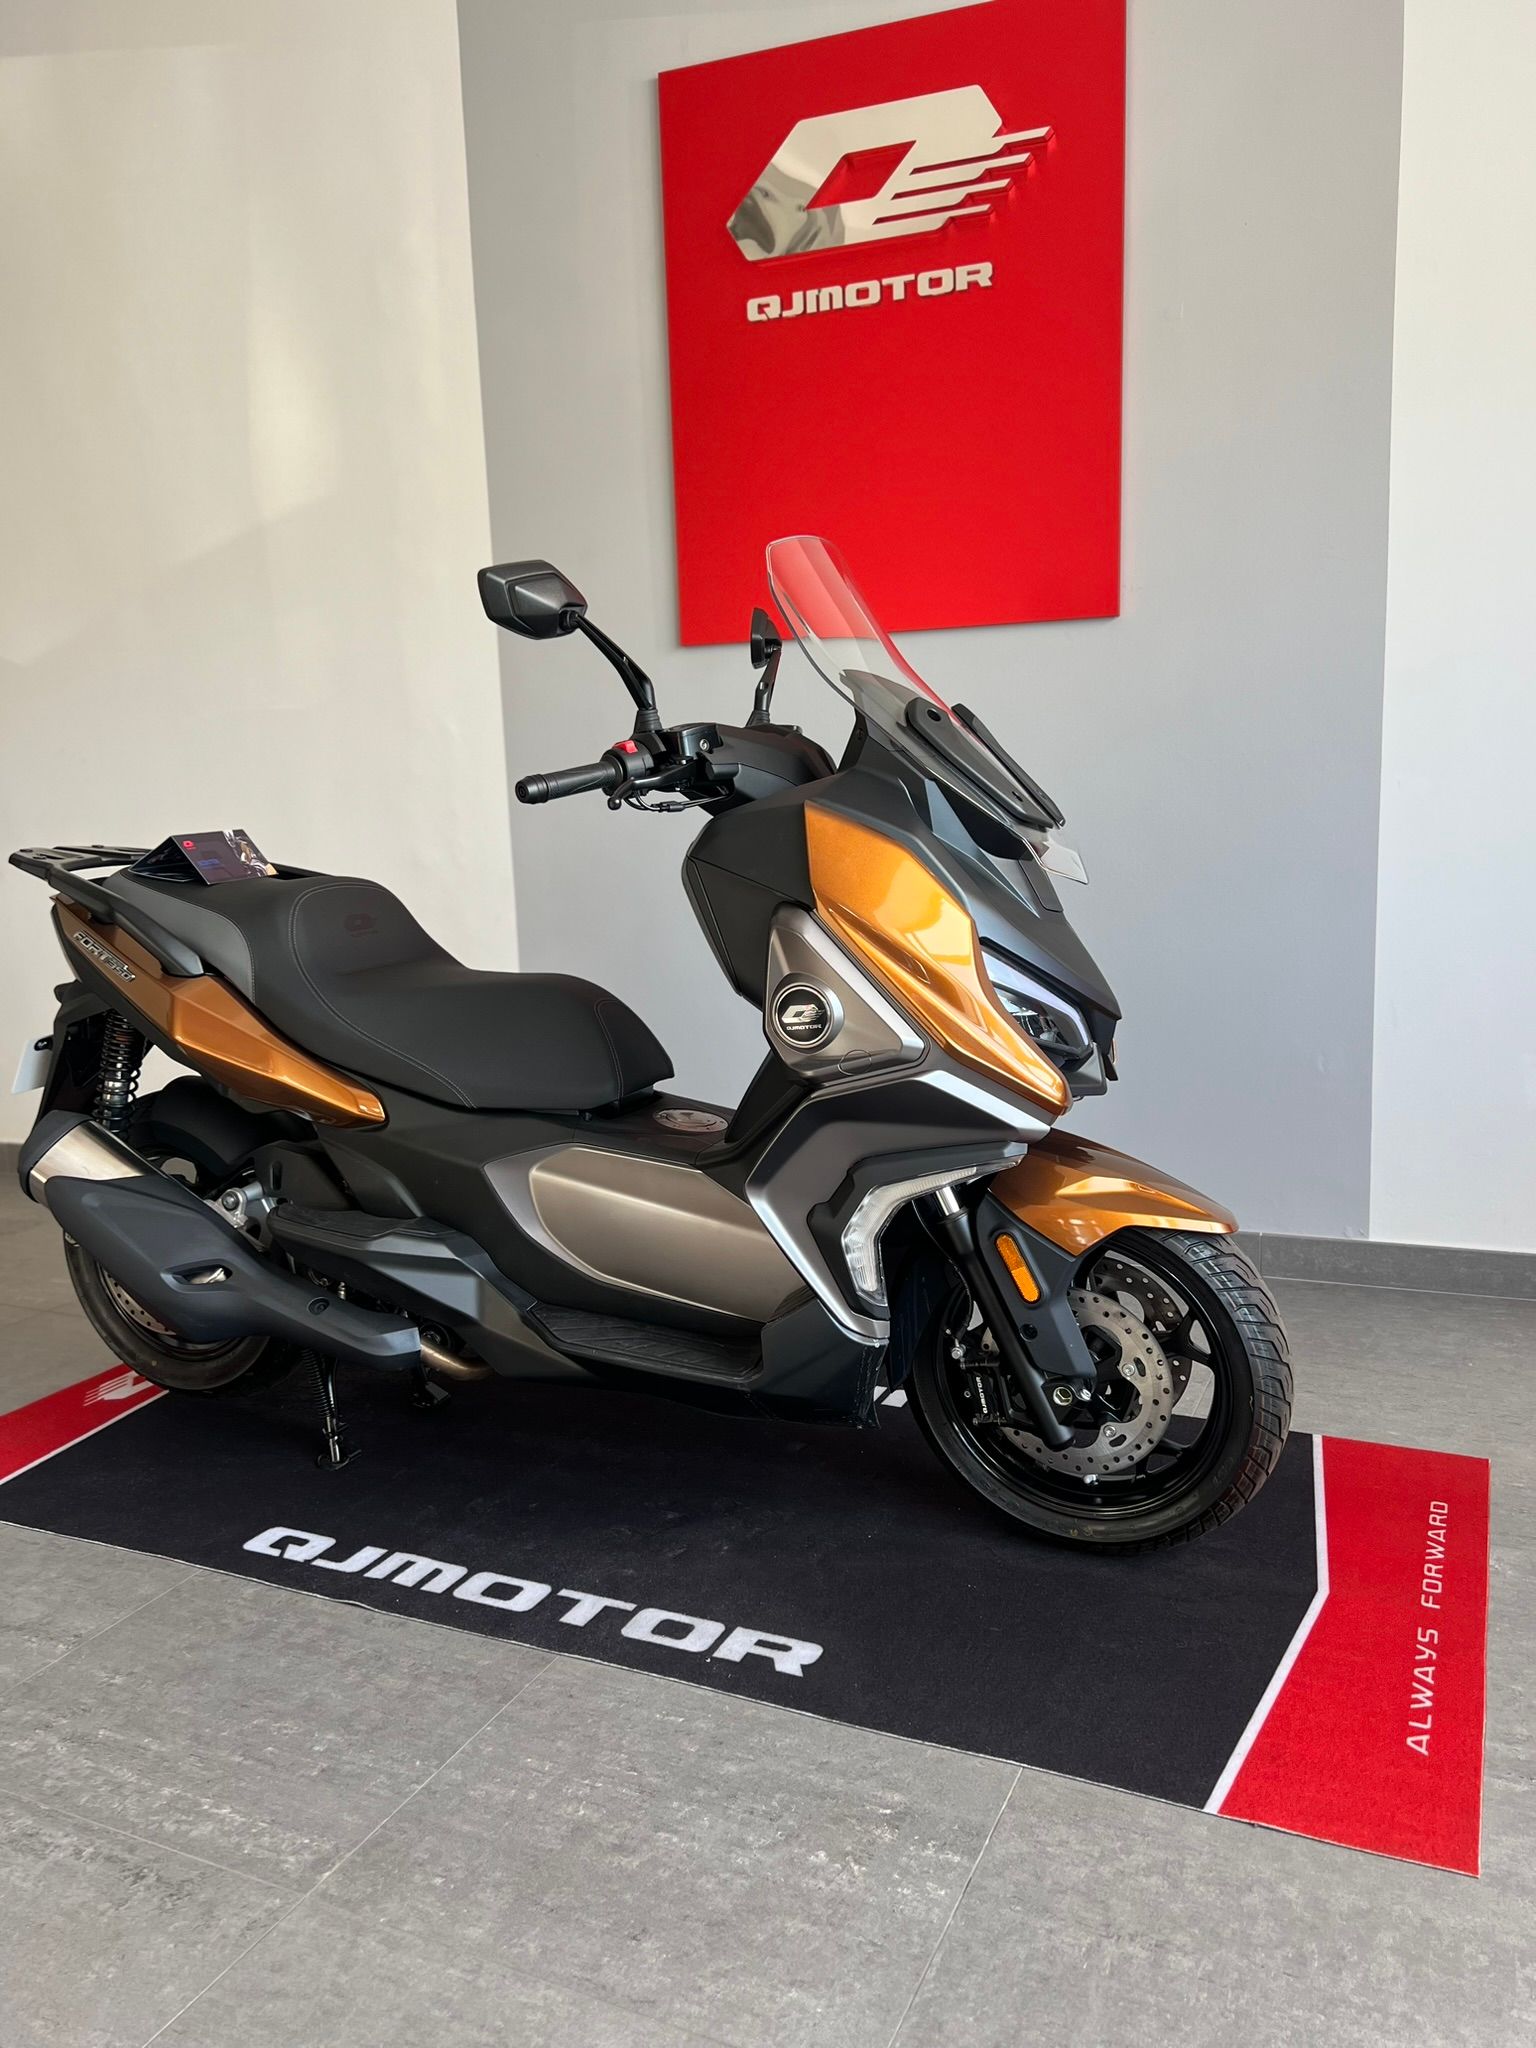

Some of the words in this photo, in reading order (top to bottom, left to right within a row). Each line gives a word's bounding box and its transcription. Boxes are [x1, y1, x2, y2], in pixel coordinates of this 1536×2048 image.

[746, 262, 993, 321] QJMOTOR
[976, 1376, 988, 1414] QJMOTOR
[242, 1526, 825, 1677] QJMOTOR
[1421, 1501, 1449, 1610] FORWARD
[1406, 1627, 1439, 1756] ALWAYS
